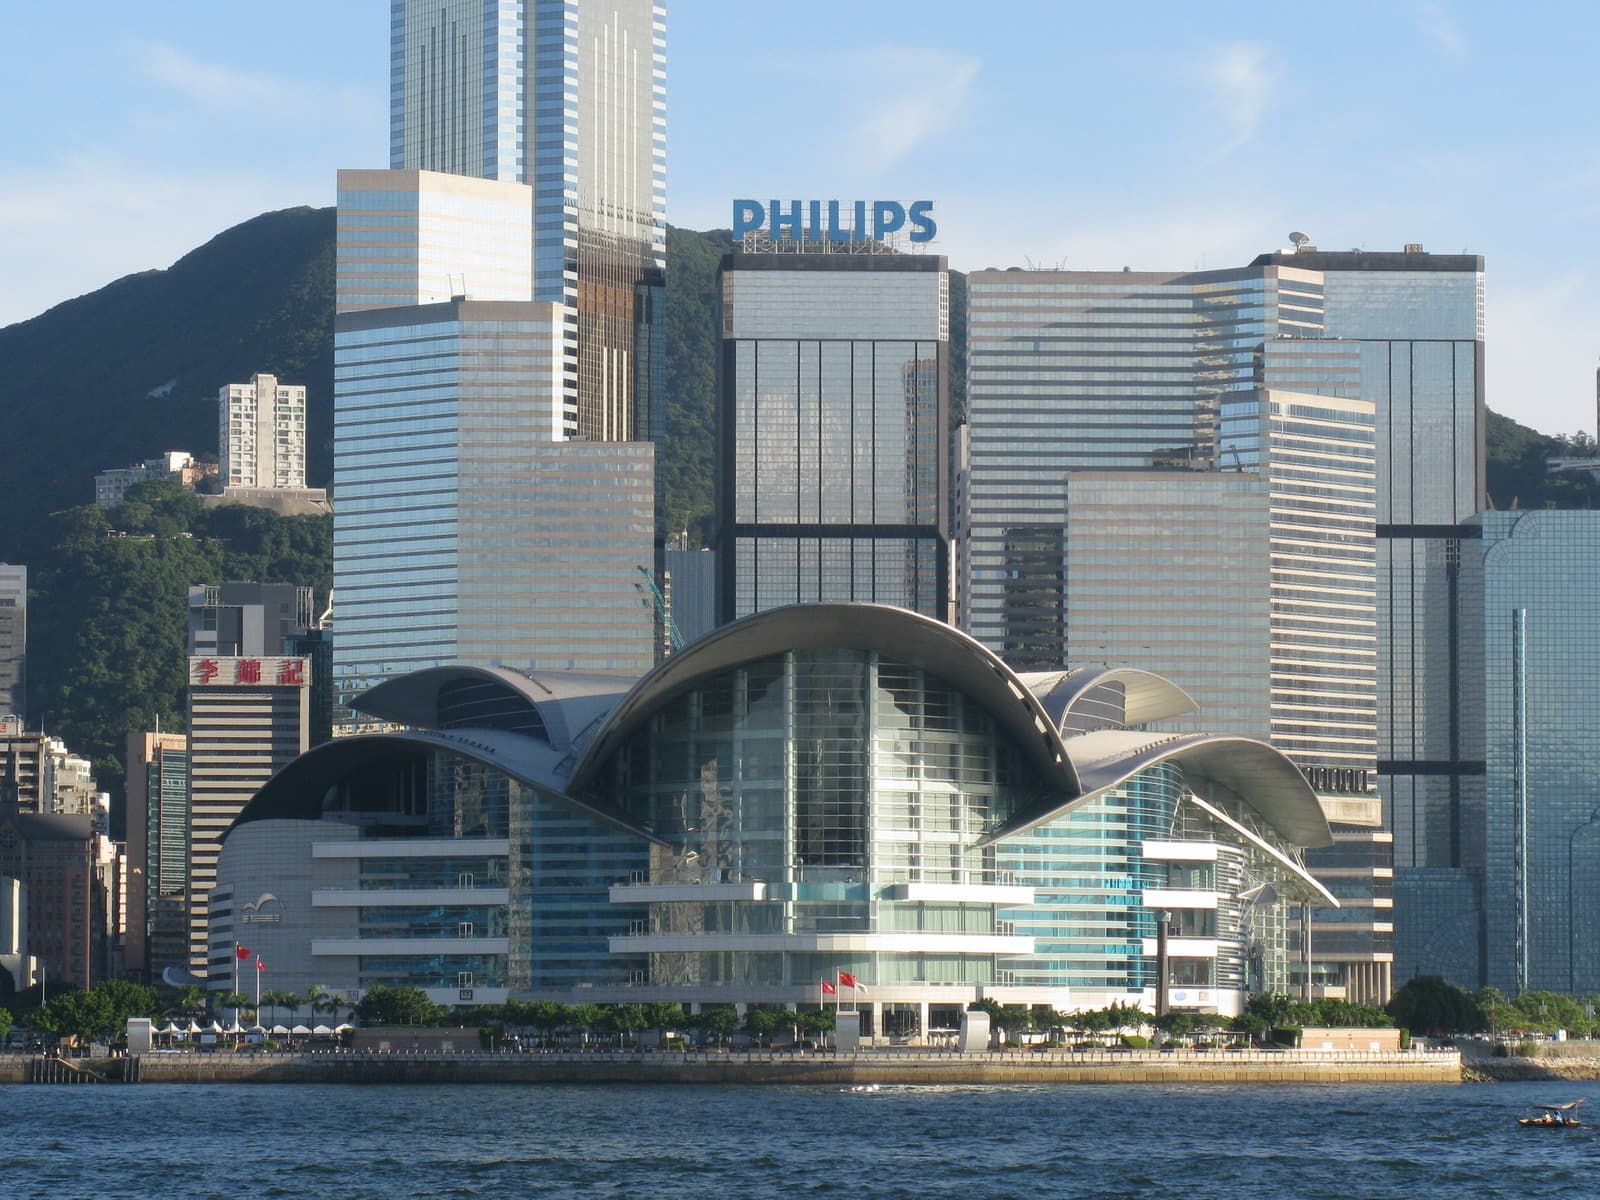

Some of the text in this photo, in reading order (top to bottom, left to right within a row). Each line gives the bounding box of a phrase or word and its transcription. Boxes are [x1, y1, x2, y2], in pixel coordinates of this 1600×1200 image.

[733, 200, 937, 242] PHILIPS
[192, 659, 304, 684] 李錦記
